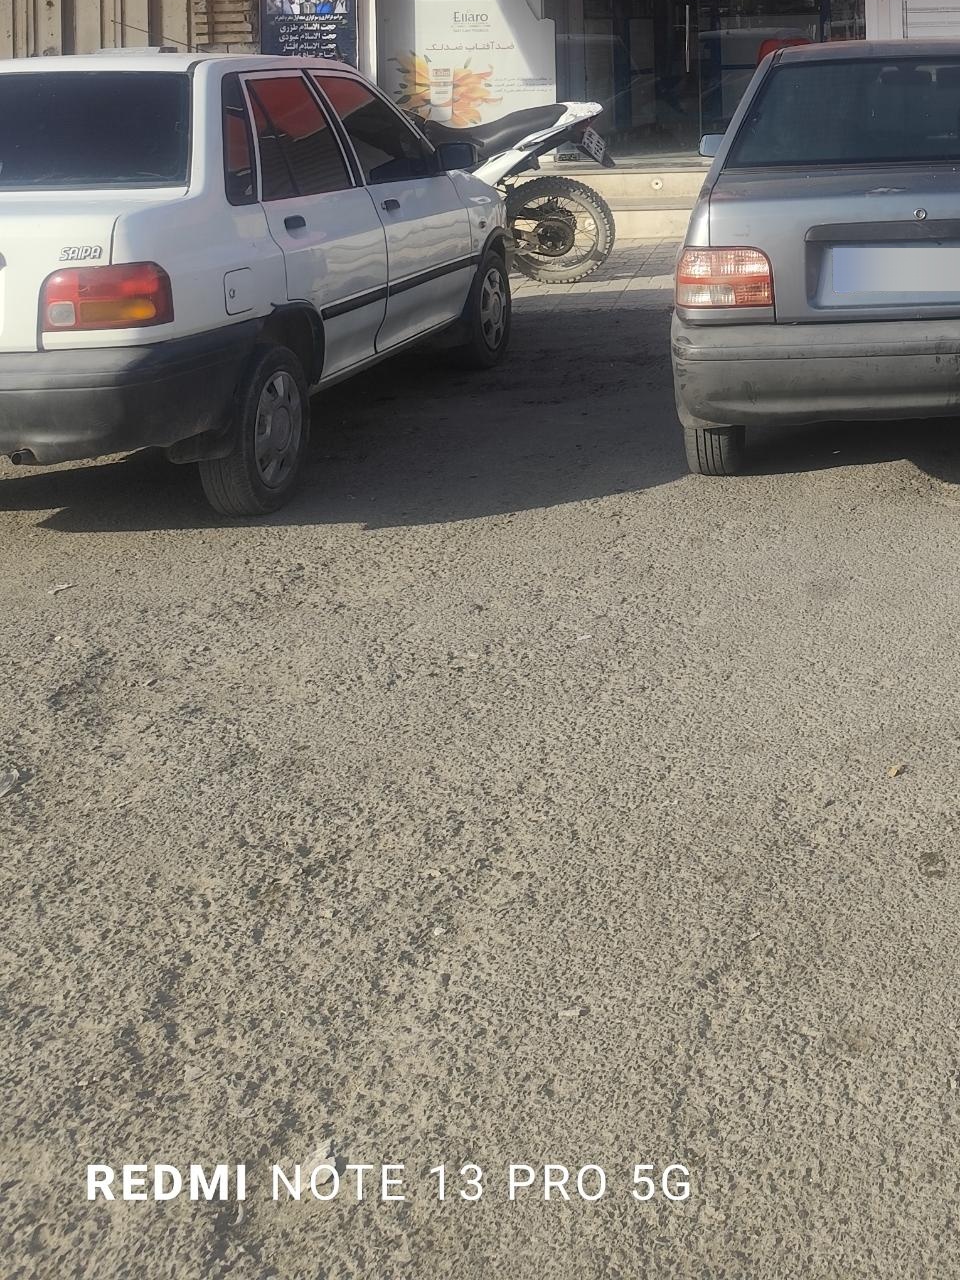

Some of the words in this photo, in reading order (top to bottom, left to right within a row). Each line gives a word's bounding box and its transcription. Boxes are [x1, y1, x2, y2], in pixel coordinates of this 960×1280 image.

[320, 23, 337, 32] حجت
[321, 32, 337, 41] حجت
[59, 245, 102, 261] SAIPA
